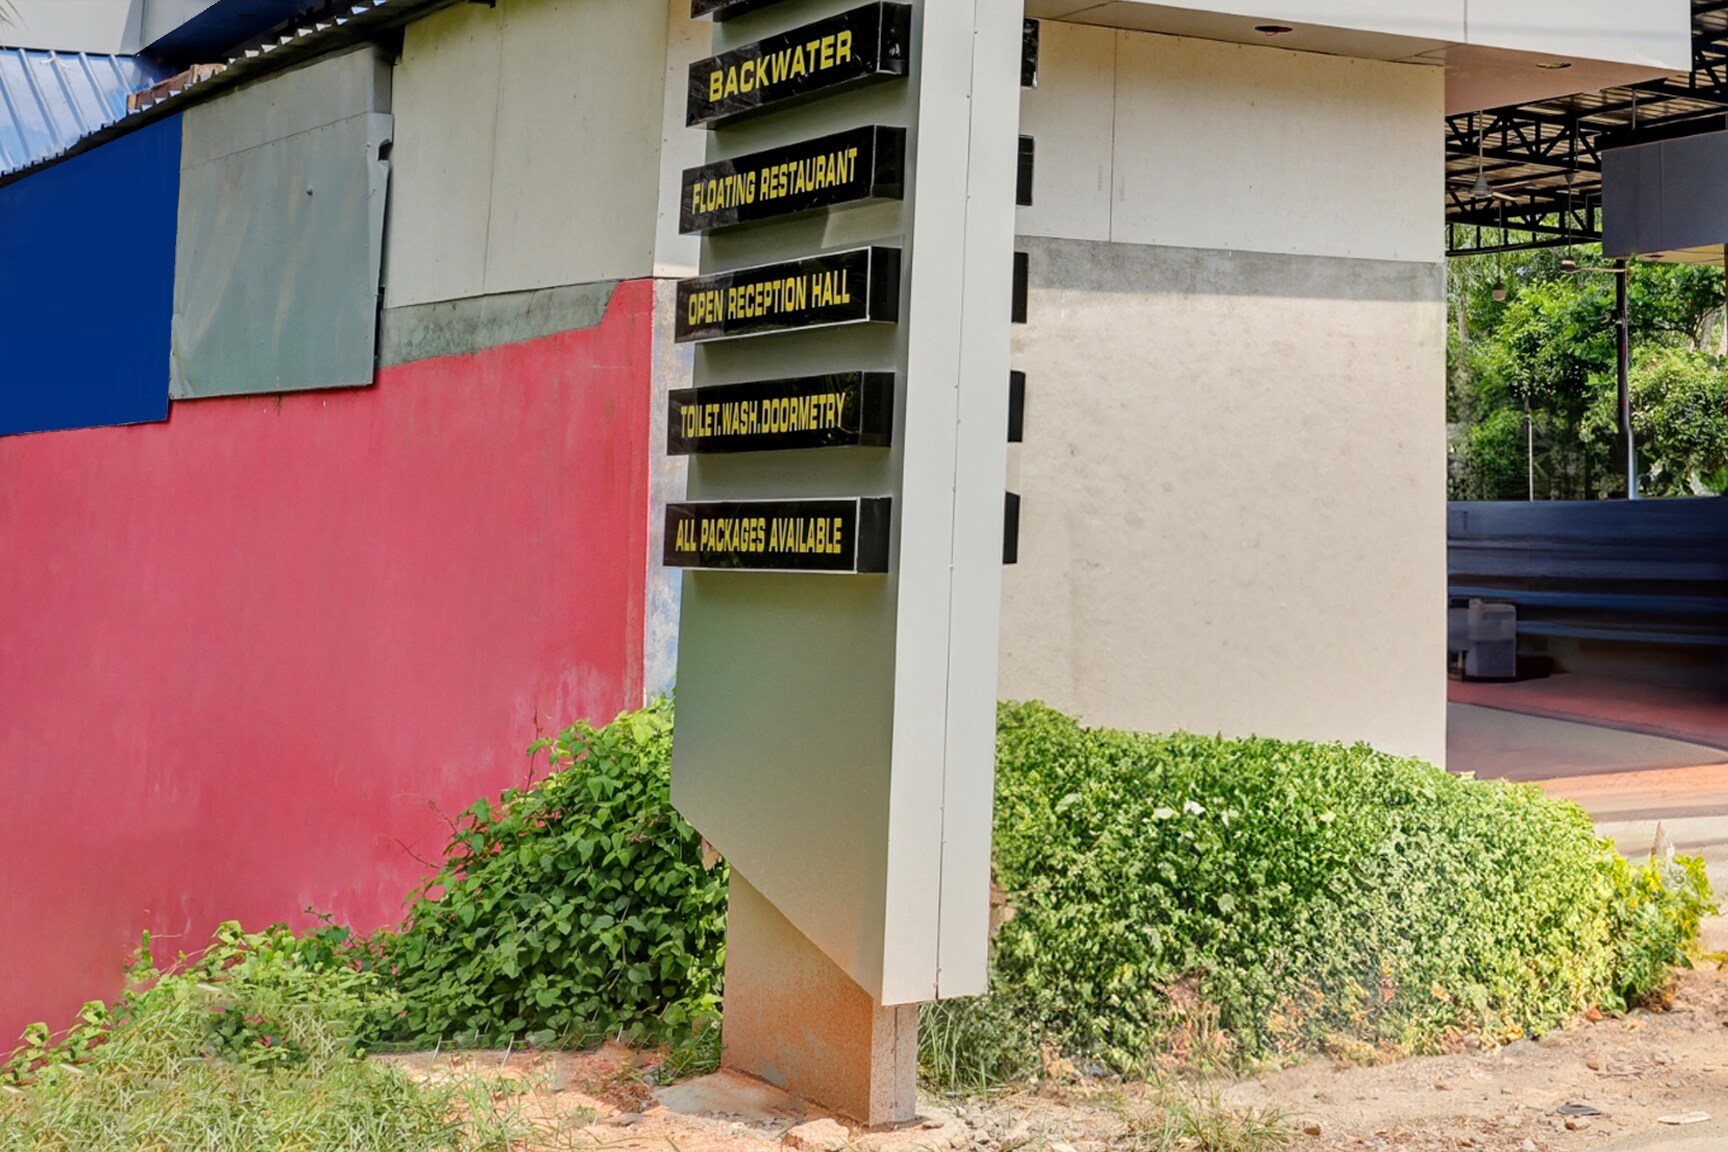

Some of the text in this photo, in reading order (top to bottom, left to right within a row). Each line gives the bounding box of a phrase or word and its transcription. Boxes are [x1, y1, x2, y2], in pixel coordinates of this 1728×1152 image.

[708, 29, 853, 103] BACKWATER
[691, 146, 857, 215] FLOATING RESTAURANT
[688, 269, 851, 325] OPEN RECEPTION HALL
[675, 517, 843, 554] ALL PACKAGES AVAILABLE
